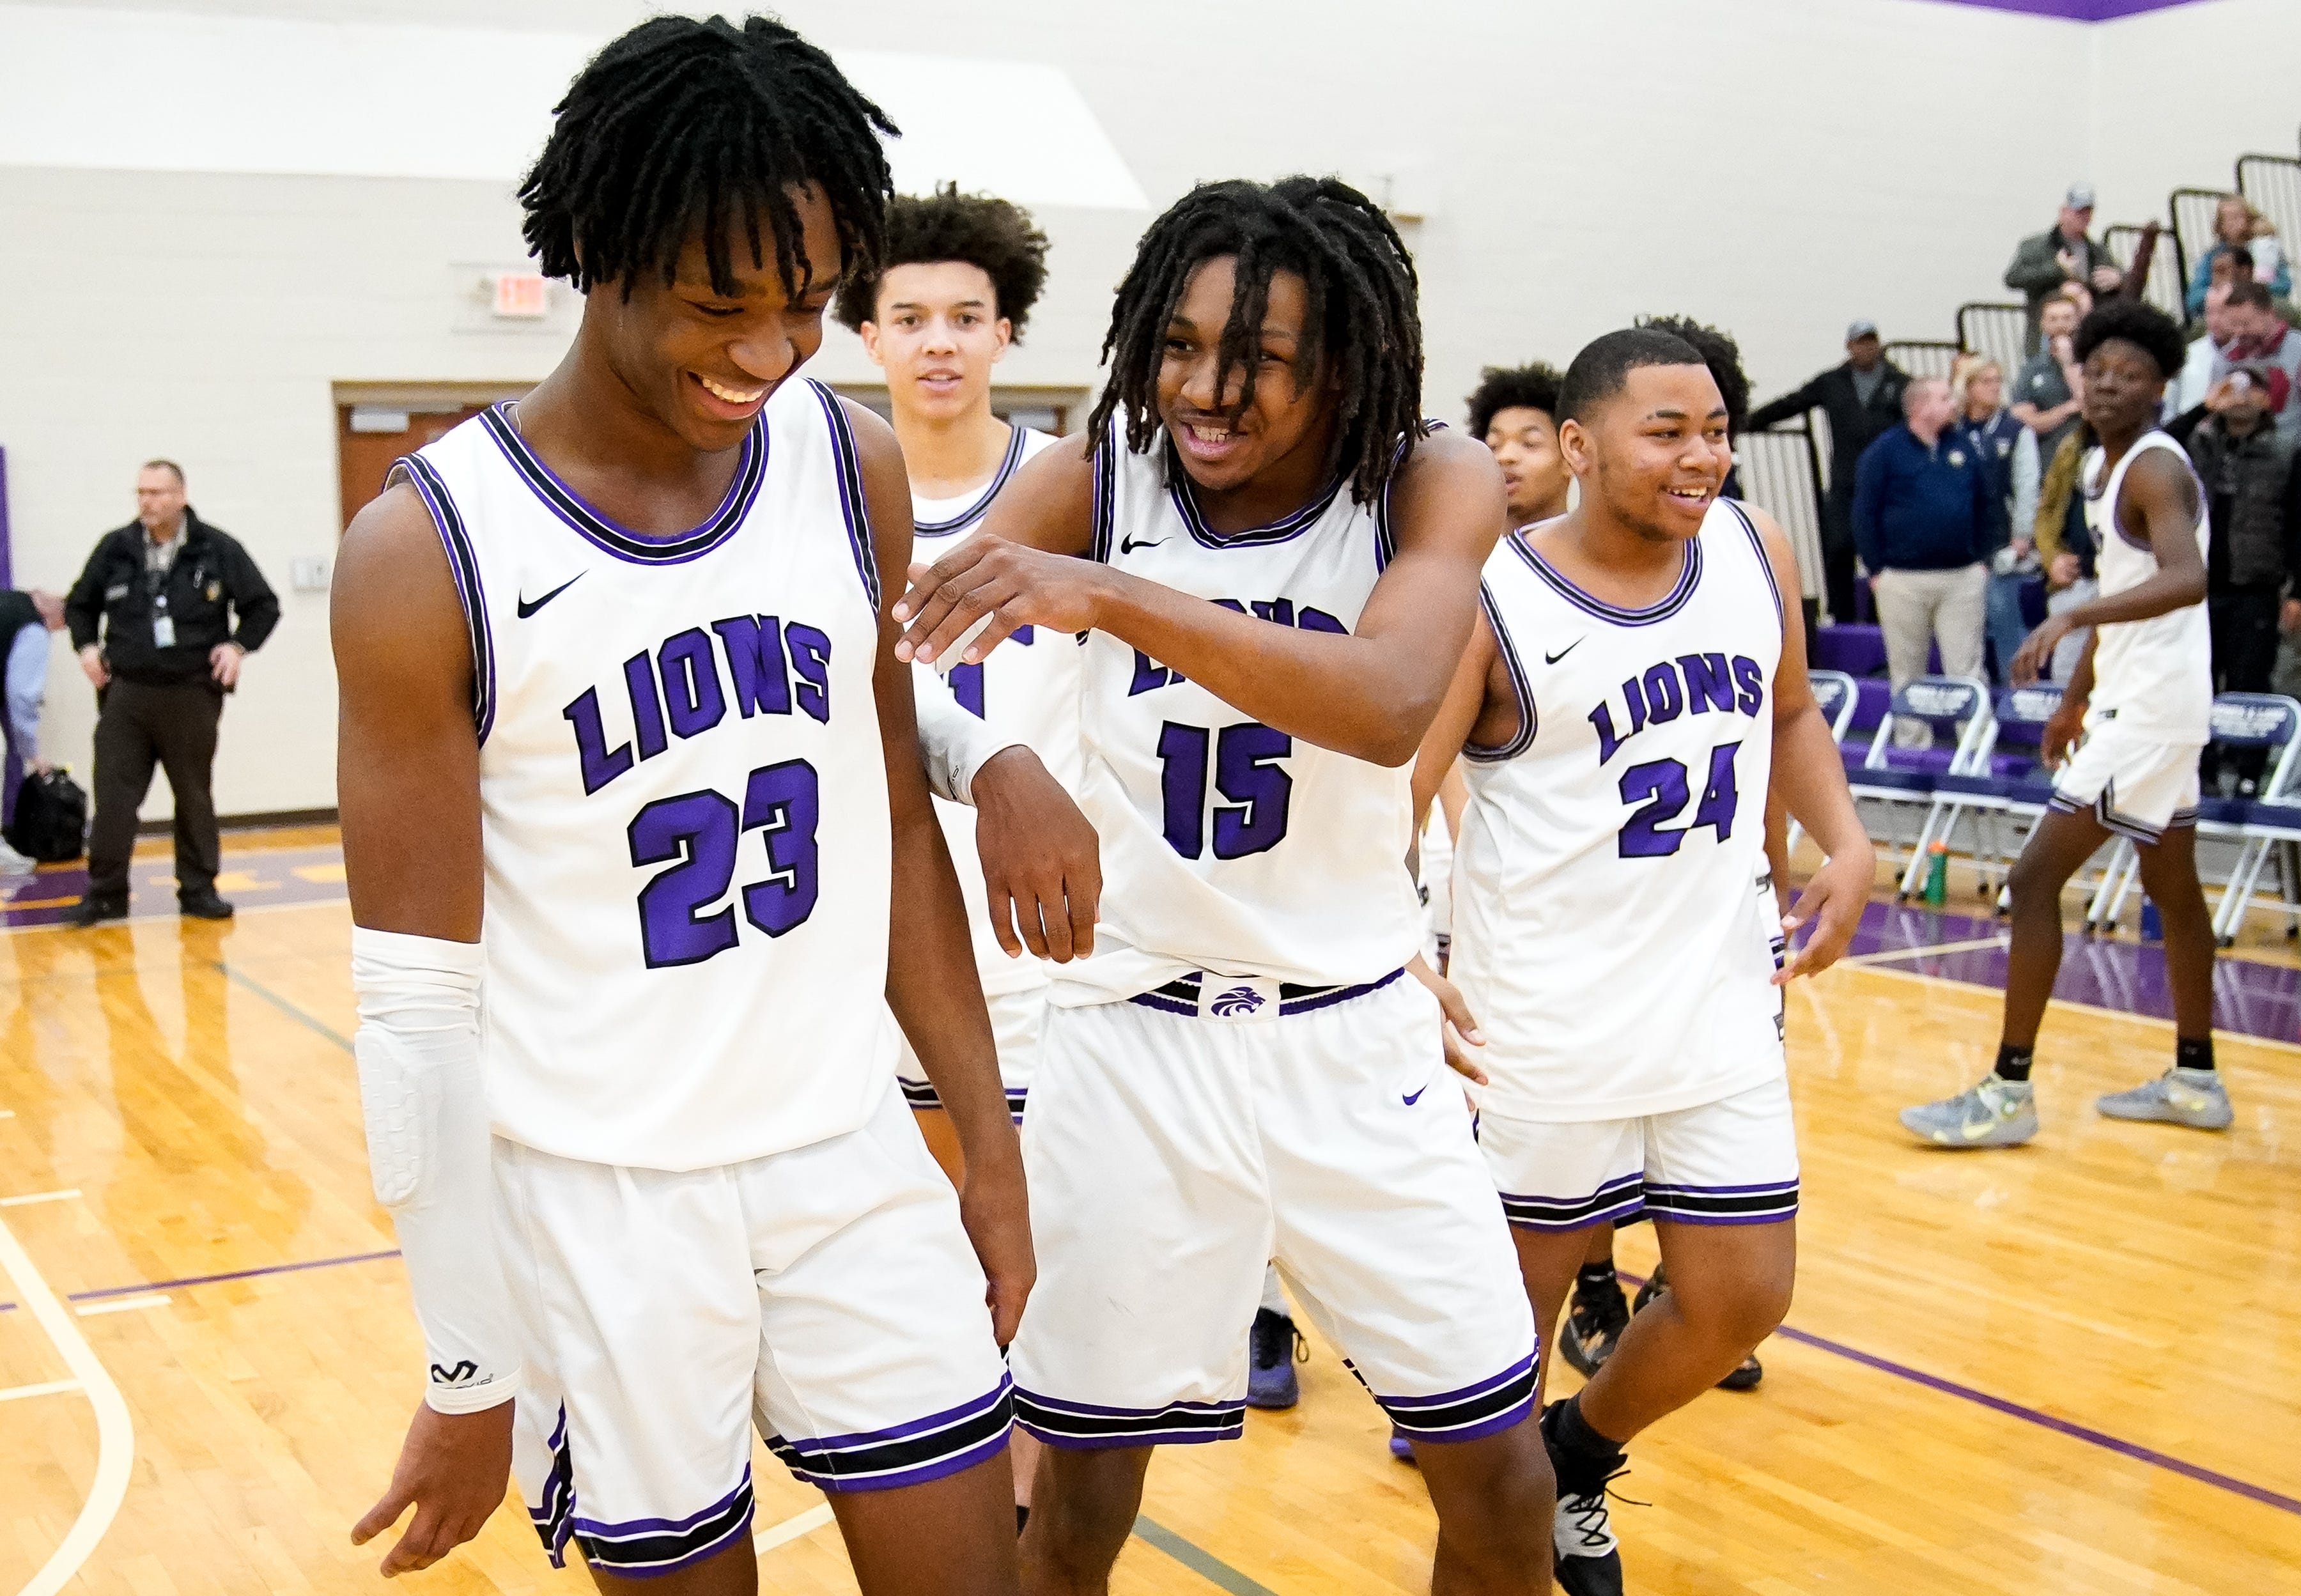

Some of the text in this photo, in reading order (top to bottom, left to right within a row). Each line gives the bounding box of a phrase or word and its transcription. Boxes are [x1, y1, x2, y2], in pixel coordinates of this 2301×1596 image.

[563, 614, 831, 796] LIONS
[1588, 653, 1763, 767] LIONS
[1156, 720, 1293, 861] 15
[1618, 740, 1744, 859] 24
[626, 757, 819, 970] 23
